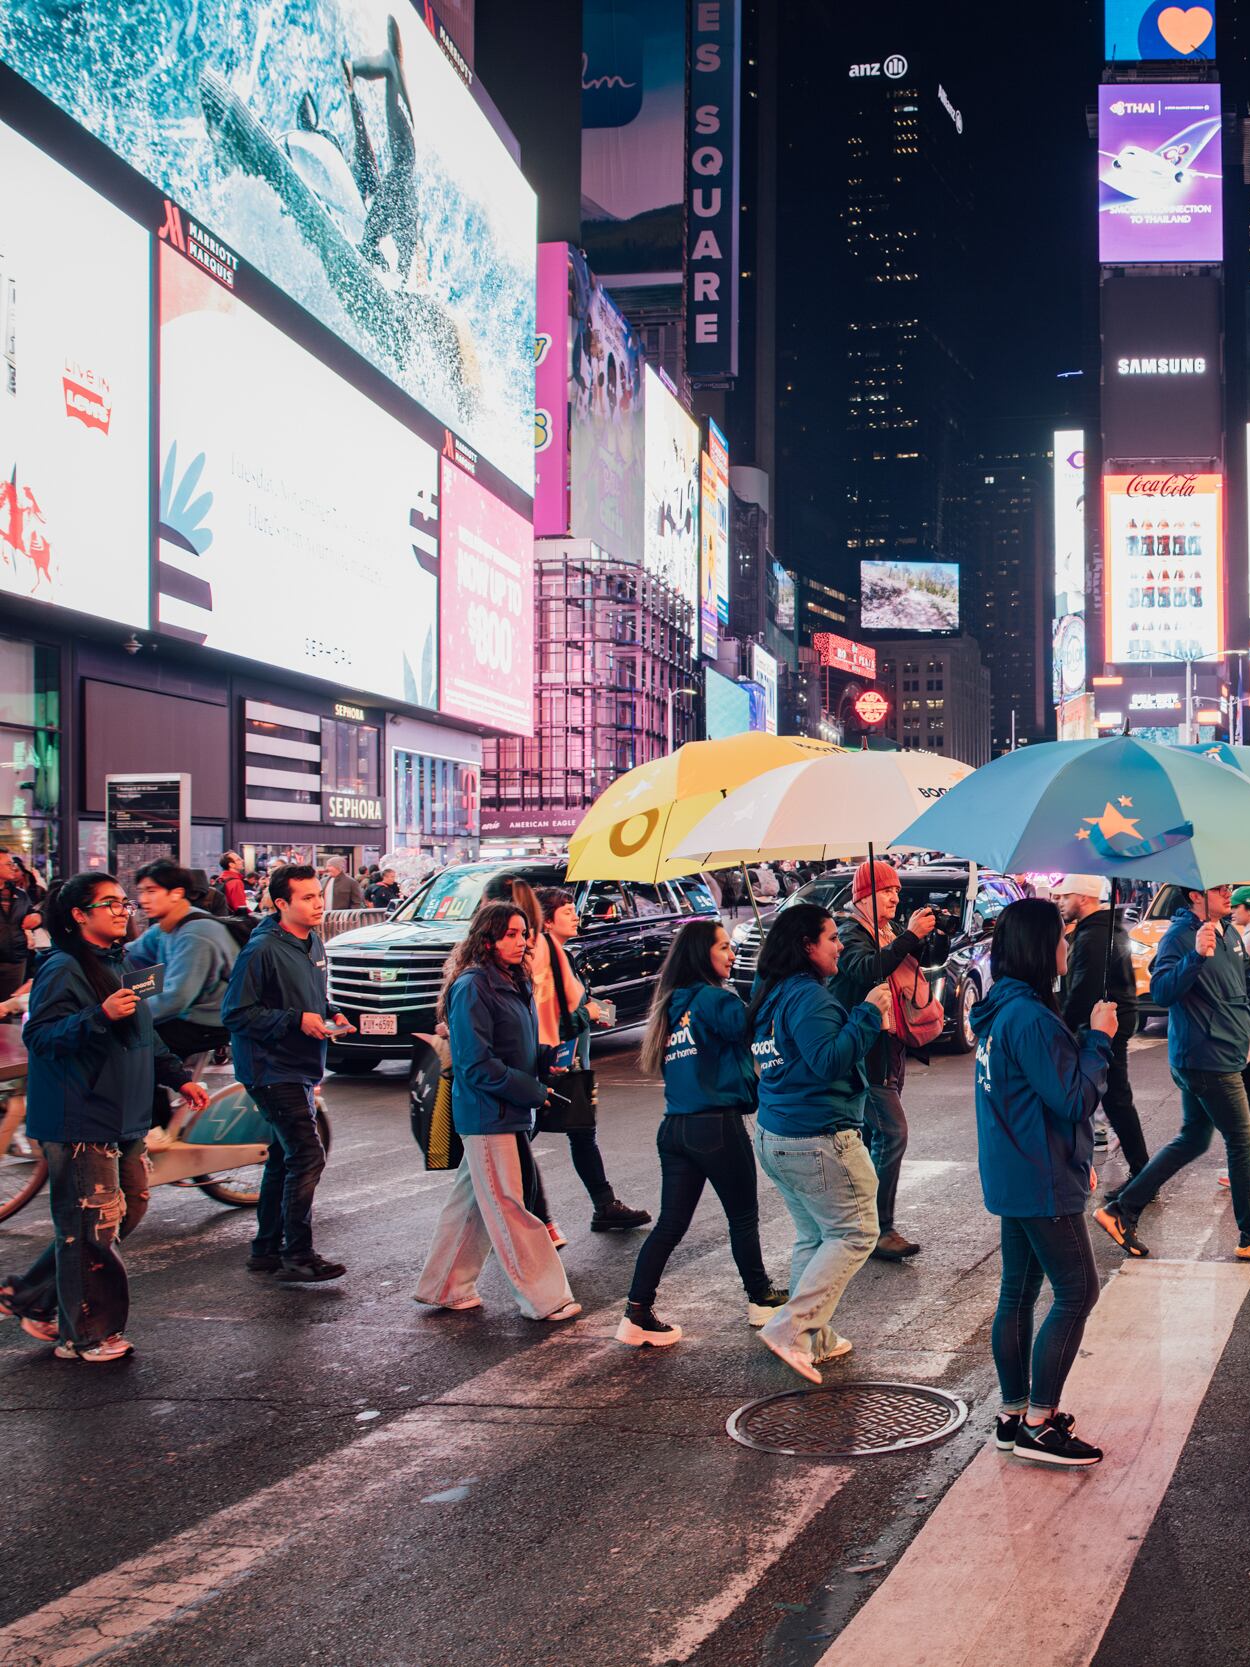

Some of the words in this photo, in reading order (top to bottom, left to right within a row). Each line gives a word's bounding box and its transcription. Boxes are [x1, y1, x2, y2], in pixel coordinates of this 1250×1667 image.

[440, 25, 472, 84] MARRIOTT
[849, 63, 881, 77] anz
[1125, 103, 1155, 114] THAI
[692, 105, 723, 343] SQUARE
[1130, 215, 1144, 224] TO
[1145, 214, 1192, 224] THAILAND
[189, 221, 239, 271] MARRIOTT
[189, 240, 234, 285] MARQUIS
[1118, 357, 1207, 375] SAMSUNG
[334, 703, 365, 721] SEPHORA
[329, 796, 382, 821] SEPHORA
[509, 820, 549, 829] AMERICAN
[552, 819, 577, 828] EAGLE
[677, 1047, 698, 1058] home
